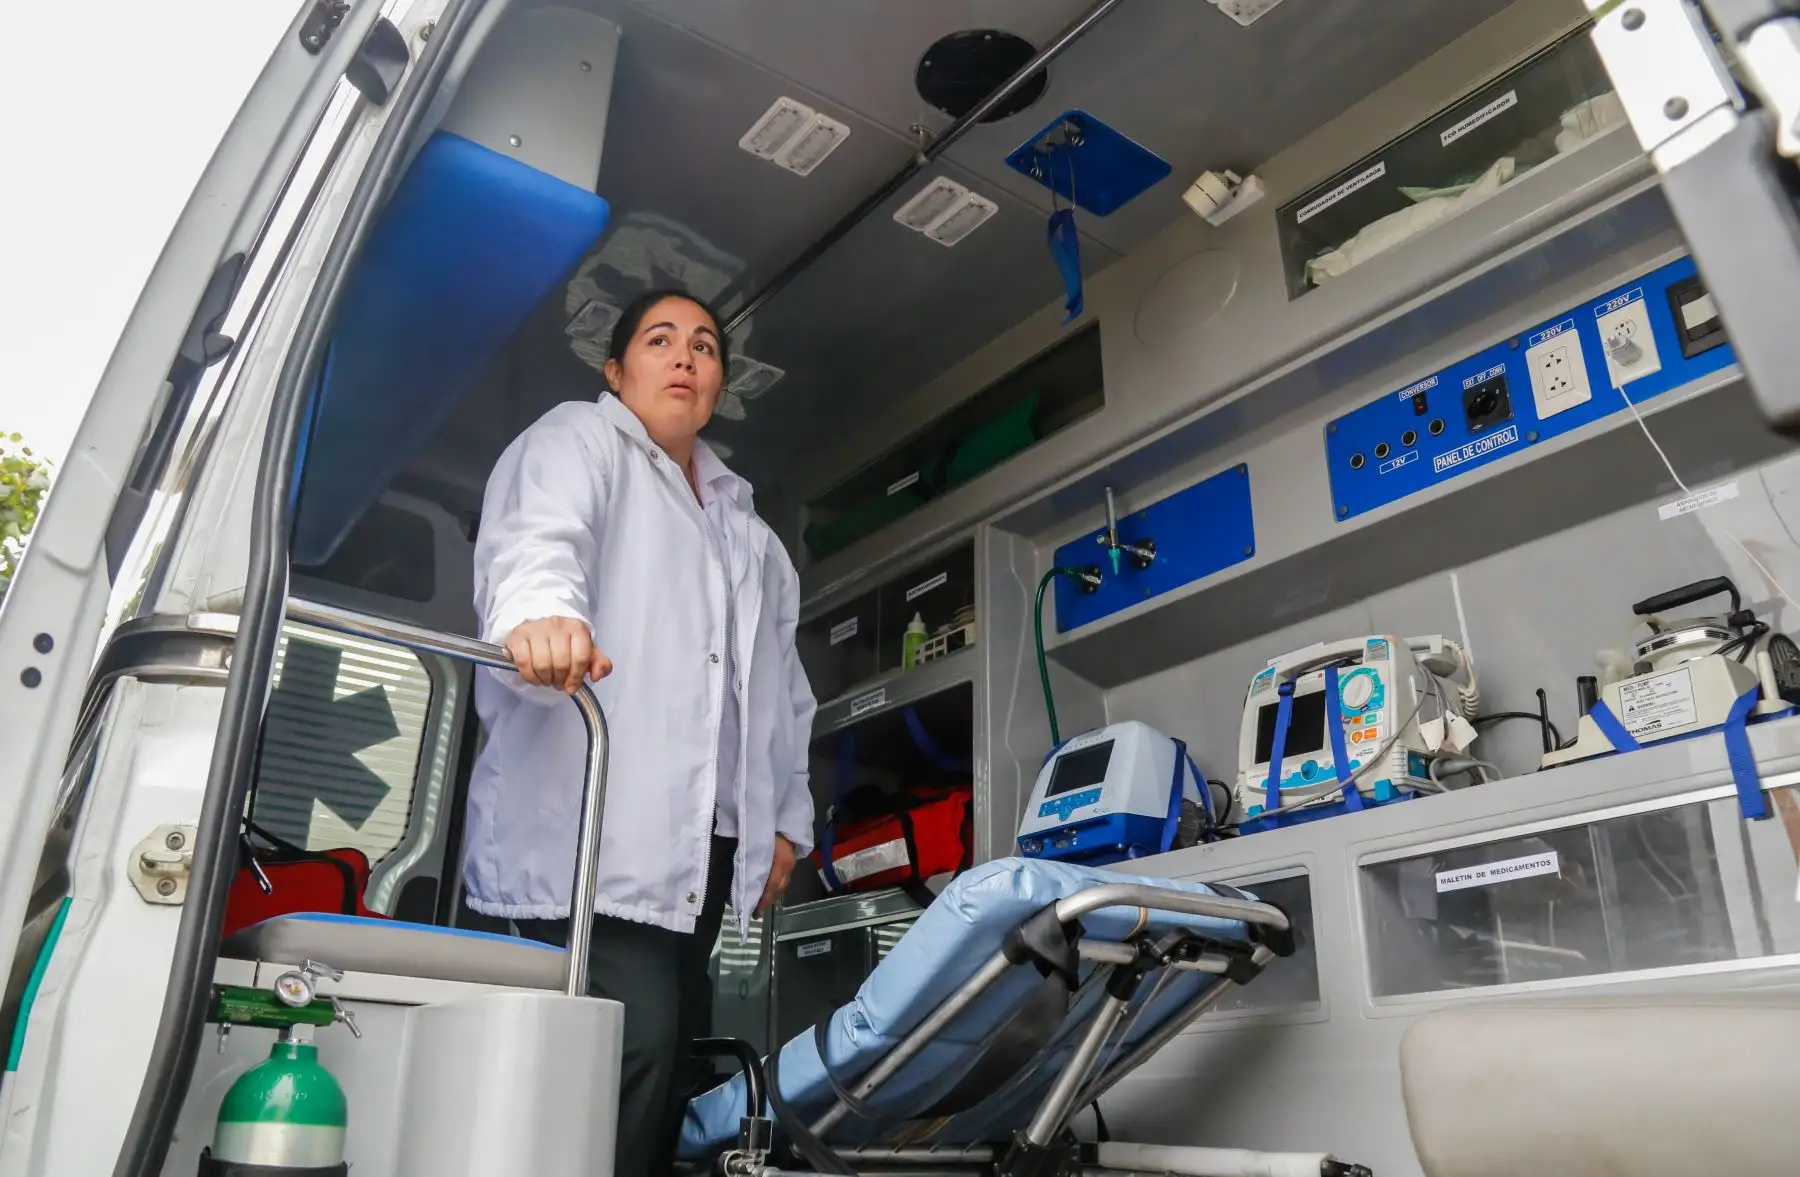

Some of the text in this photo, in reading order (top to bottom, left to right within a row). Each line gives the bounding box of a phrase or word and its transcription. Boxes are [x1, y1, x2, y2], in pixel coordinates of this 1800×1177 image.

[1457, 98, 1511, 133] HUMEDIFICADOR
[1345, 167, 1382, 192] VENTILADOR
[1606, 294, 1630, 311] 220V
[1540, 325, 1563, 341] 220V
[1401, 378, 1437, 400] CONVERSOR
[1436, 430, 1515, 470] PANEL DE CONTROL
[1391, 456, 1406, 469] 12V
[1627, 722, 1663, 735] THOMAS
[1440, 859, 1552, 885] MALETIN DE MEDICAMENTOS
